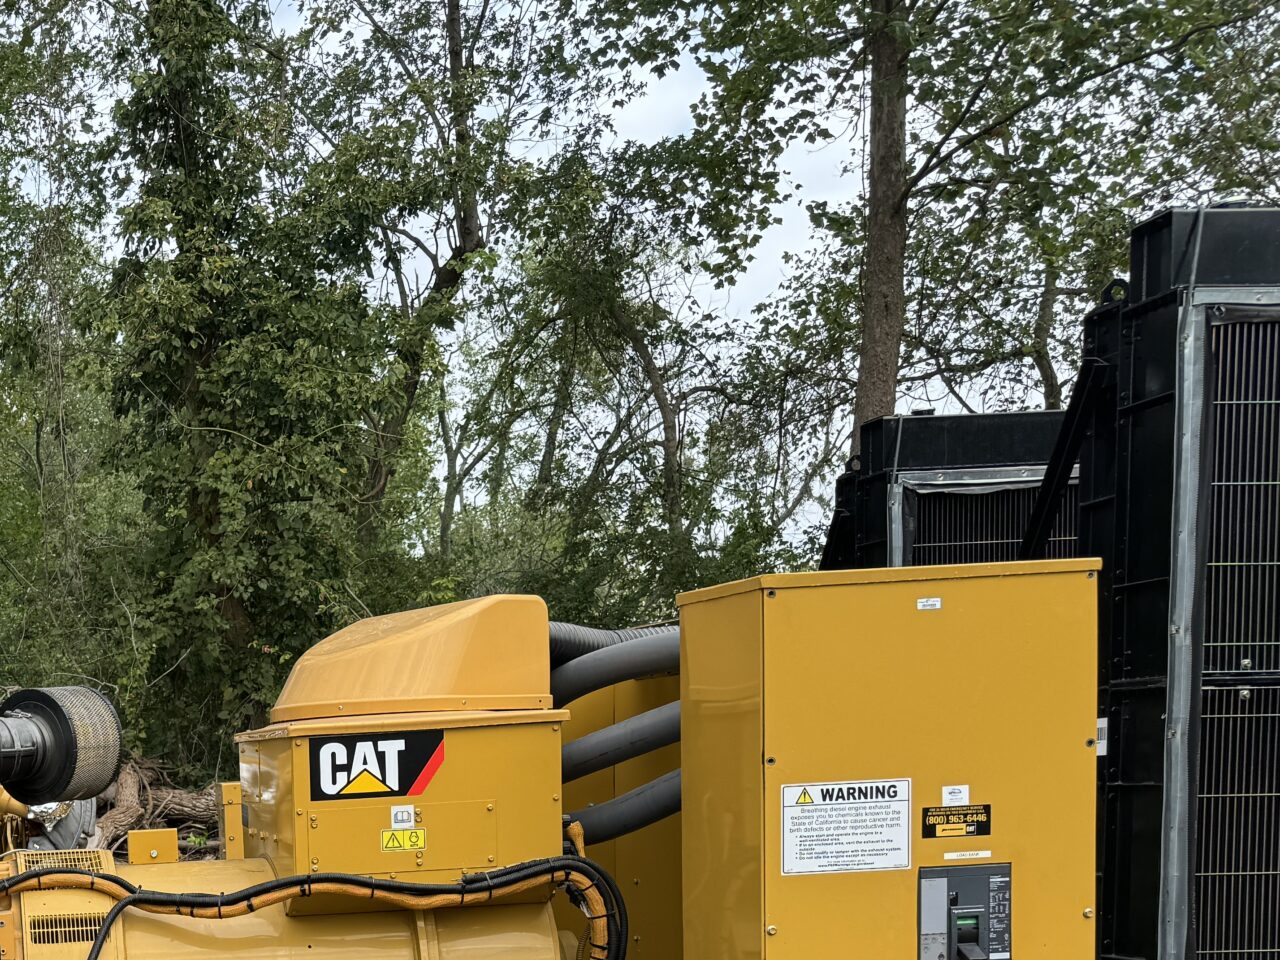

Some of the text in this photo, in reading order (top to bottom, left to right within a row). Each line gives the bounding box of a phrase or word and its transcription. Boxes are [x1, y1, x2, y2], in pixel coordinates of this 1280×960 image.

[320, 739, 406, 795] CAT
[821, 785, 898, 802] WARNING
[926, 814, 987, 824] (800) 963-6446
